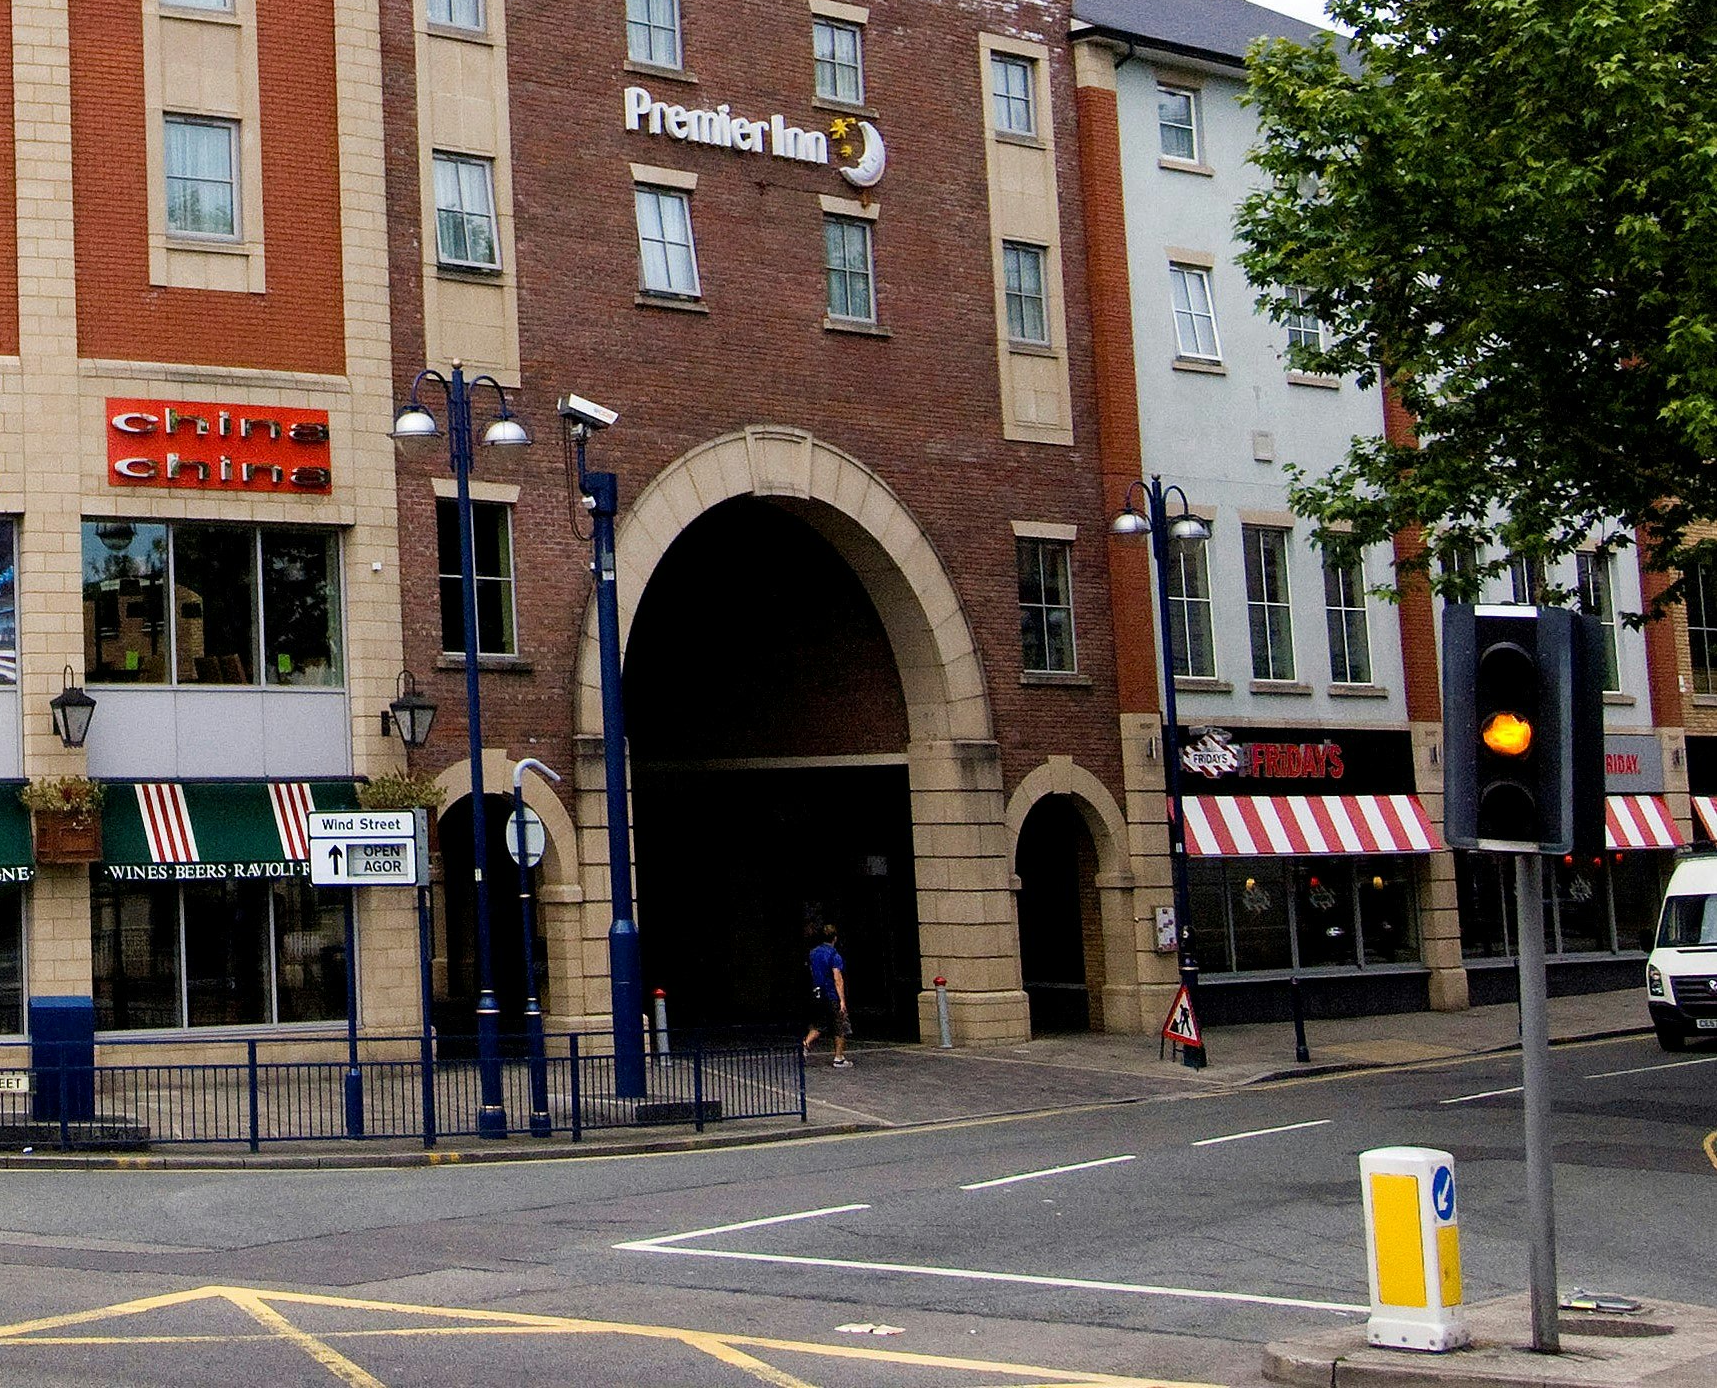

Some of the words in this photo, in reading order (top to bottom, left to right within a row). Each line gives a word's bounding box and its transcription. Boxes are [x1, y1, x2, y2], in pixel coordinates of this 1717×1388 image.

[624, 85, 770, 154] Premier
[770, 113, 829, 164] Inn
[111, 407, 330, 442] china
[114, 453, 331, 488] china
[1605, 754, 1641, 774] RIDAY.
[322, 818, 354, 831] Wind
[359, 818, 402, 830] Street
[363, 845, 401, 857] OPEN
[109, 864, 168, 880] WINES
[174, 863, 227, 879] BEERS
[233, 861, 296, 878] RAVIOLI
[363, 860, 402, 873] AGOR
